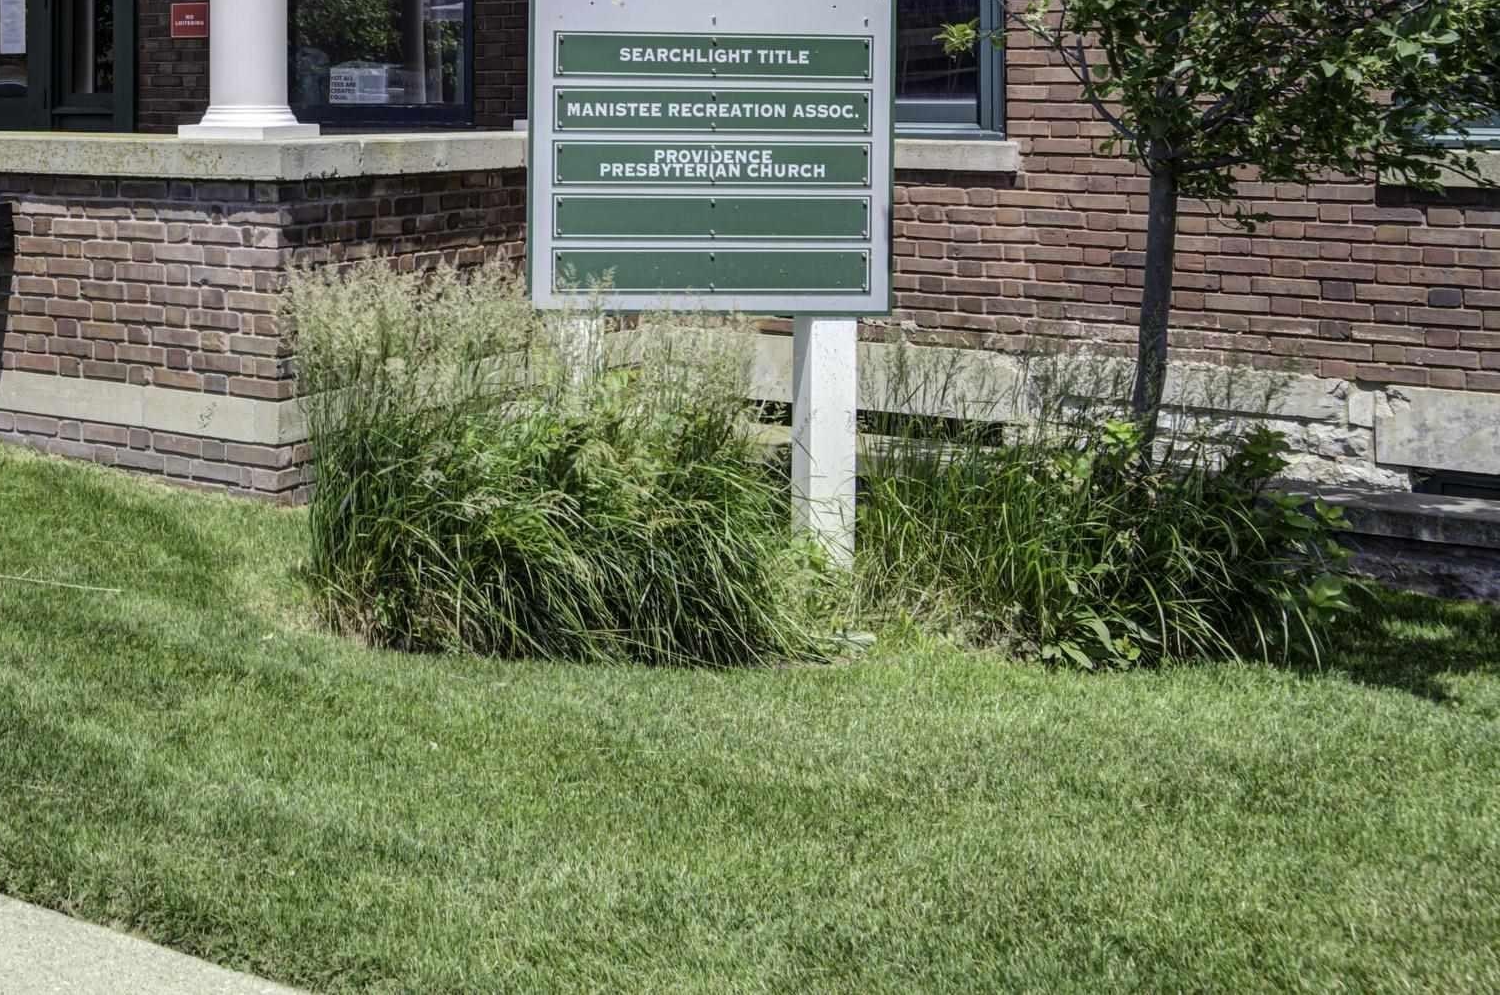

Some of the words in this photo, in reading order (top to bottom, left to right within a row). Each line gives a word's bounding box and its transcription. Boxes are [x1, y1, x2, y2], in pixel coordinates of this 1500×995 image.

[619, 47, 752, 64] SEARCHLIGHT
[757, 49, 810, 65] TITLE
[566, 102, 662, 118] MANISTEE
[668, 103, 786, 118] RECREATION
[793, 104, 859, 119] ASSOC.
[654, 149, 773, 164] PROVIDENCE
[599, 163, 741, 178] PRESBYTERIAN
[747, 164, 826, 178] CHURCH
